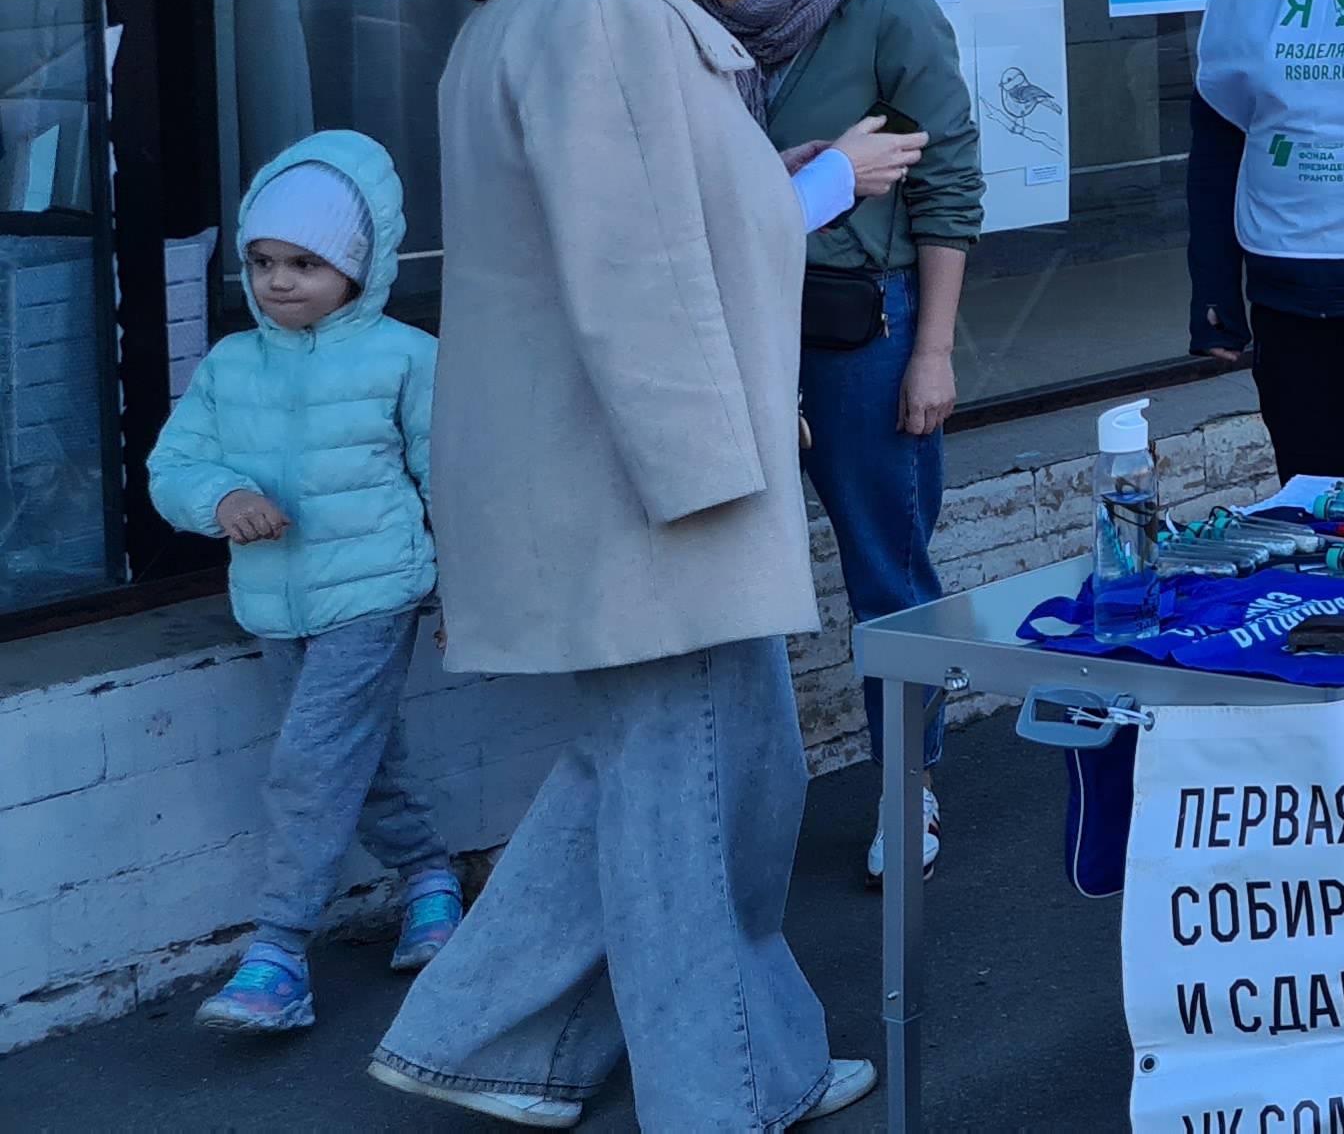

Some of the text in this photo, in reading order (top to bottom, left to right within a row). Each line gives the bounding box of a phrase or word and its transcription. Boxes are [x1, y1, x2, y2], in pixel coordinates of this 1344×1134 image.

[1298, 152, 1335, 161] ФОНДА
[1298, 173, 1344, 183] ГРАНТОВ
[1176, 982, 1214, 1035] И
